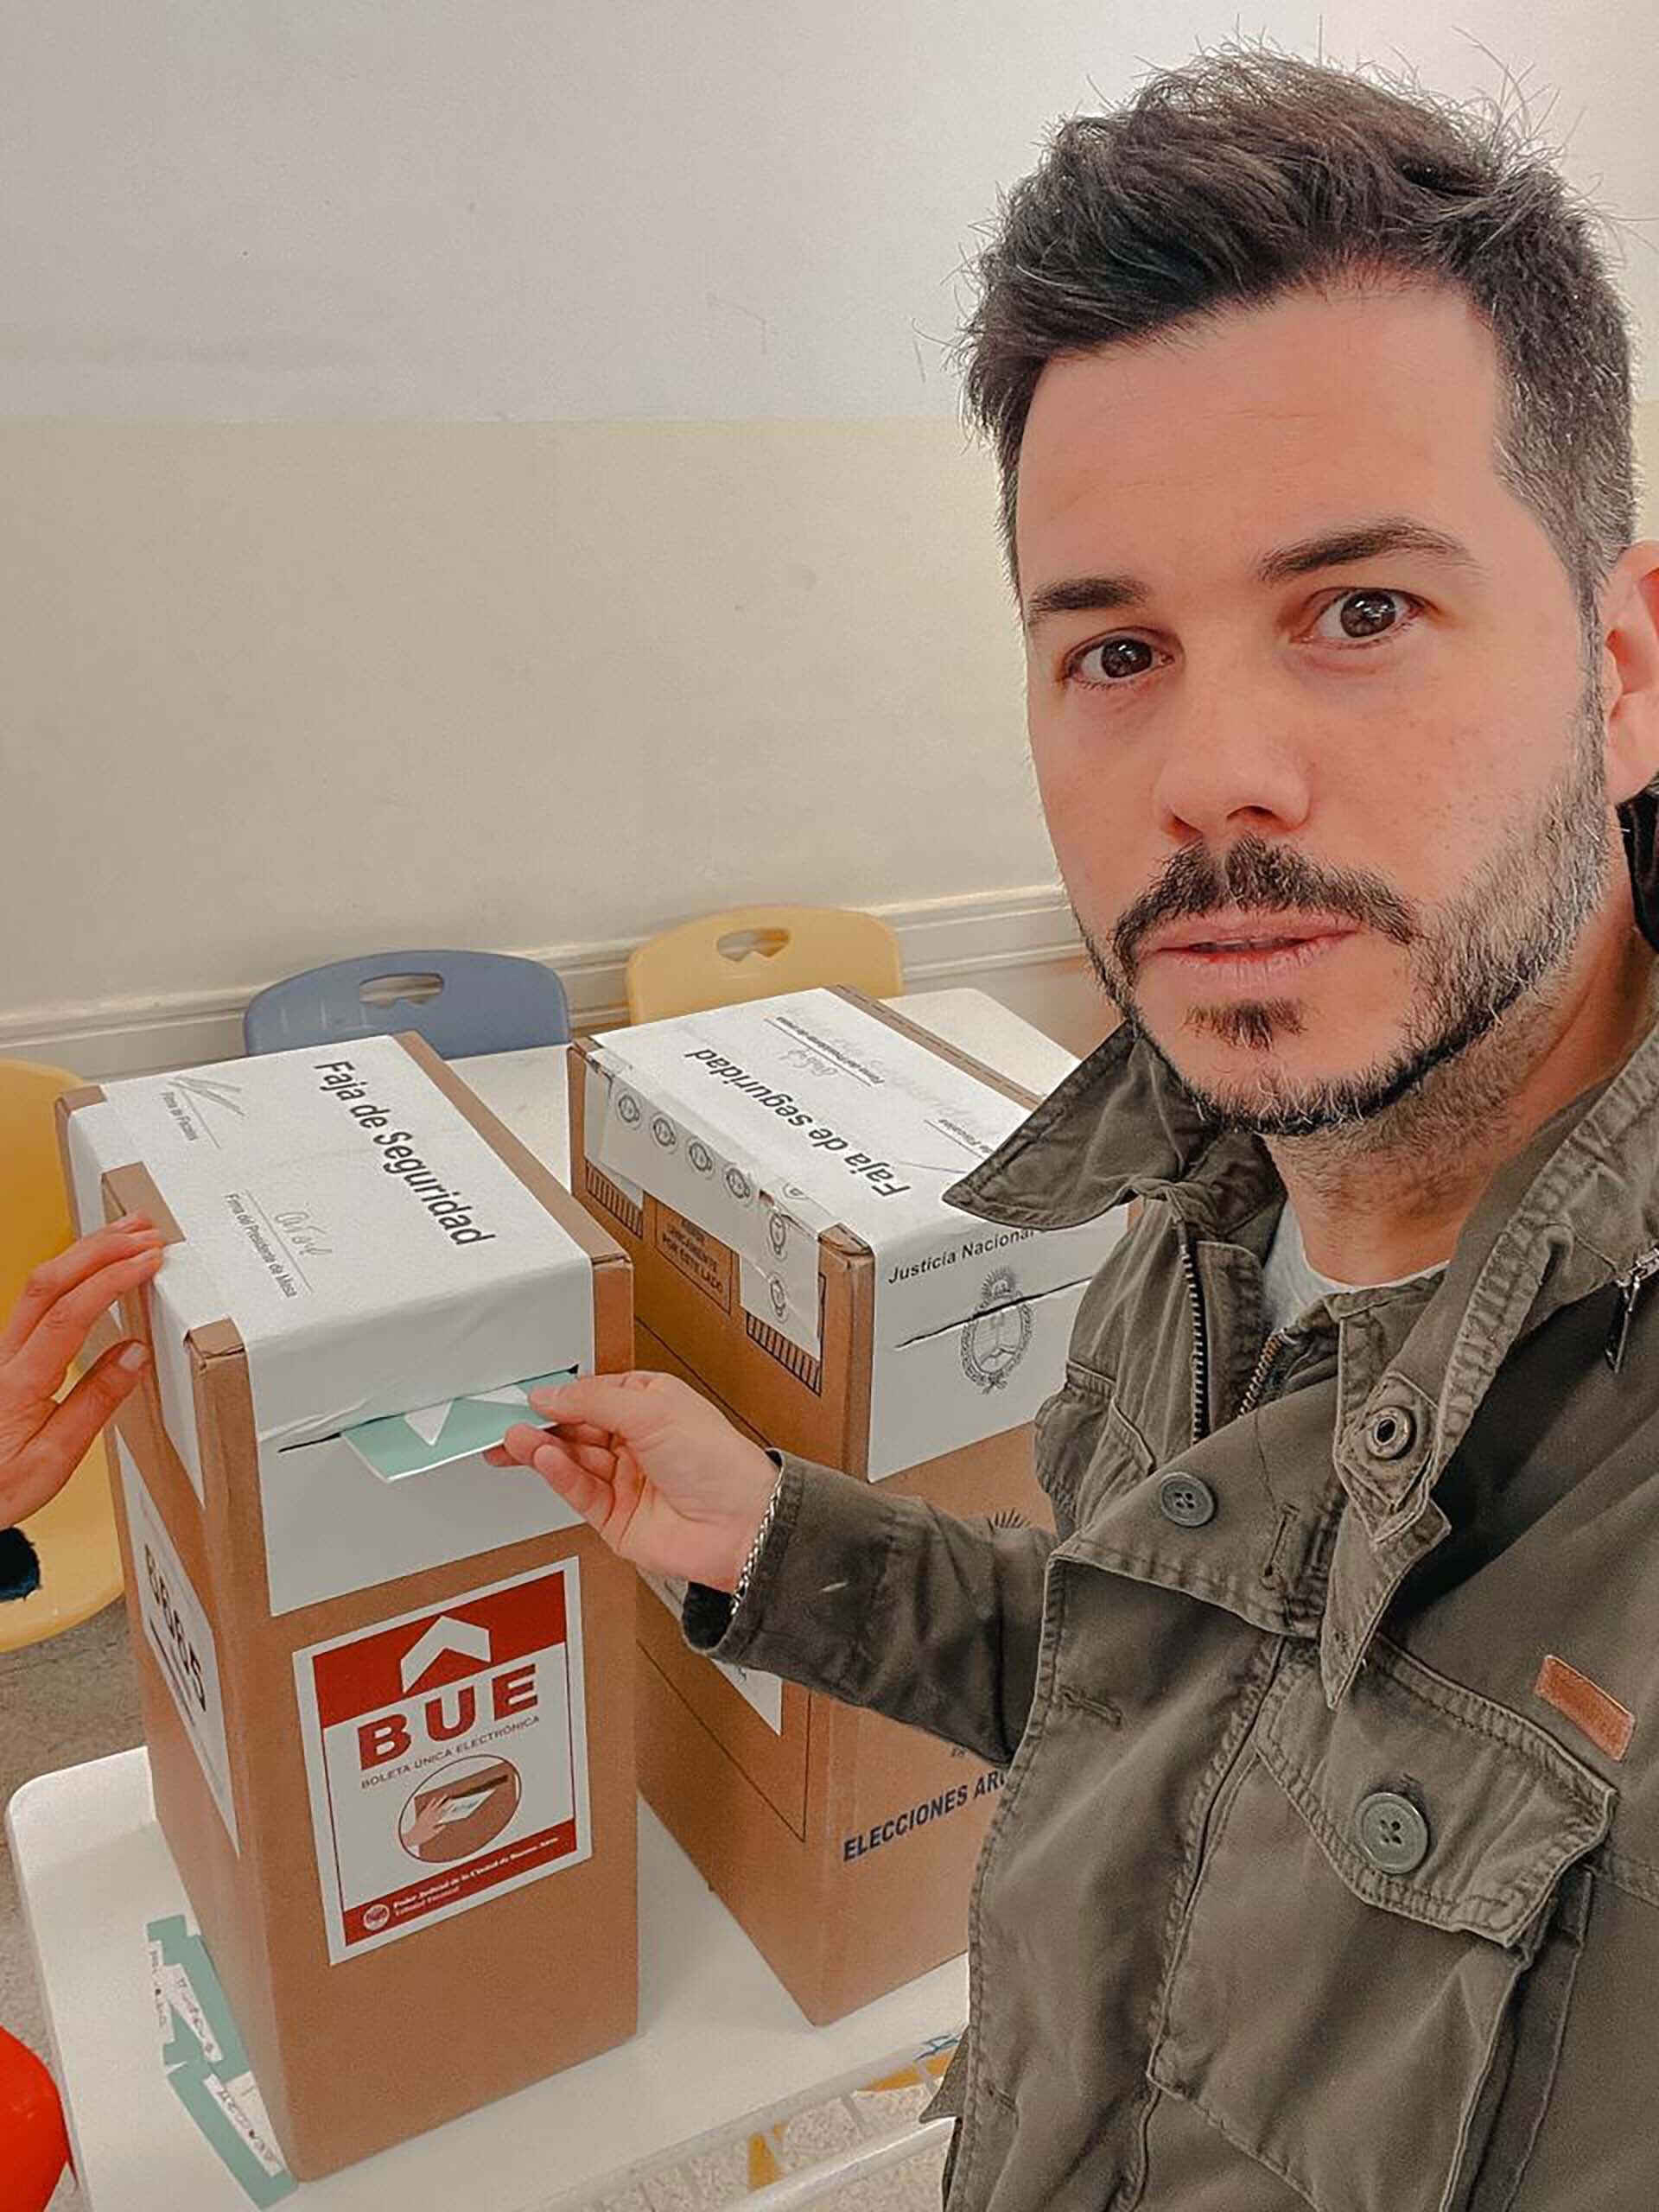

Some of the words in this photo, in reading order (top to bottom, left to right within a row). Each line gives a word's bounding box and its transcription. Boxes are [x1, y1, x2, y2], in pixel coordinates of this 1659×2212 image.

[683, 1048, 813, 1127] seguridad
[314, 1060, 369, 1101] Faja
[349, 1104, 391, 1128] de
[372, 1131, 497, 1245] Seguridad
[808, 1128, 849, 1152] de
[843, 1152, 912, 1198] Faja
[888, 1252, 957, 1284] Justicia
[358, 1663, 538, 1771] BUE
[361, 1764, 411, 1789] BOLETA
[842, 1784, 969, 1863] ELECCIONES
